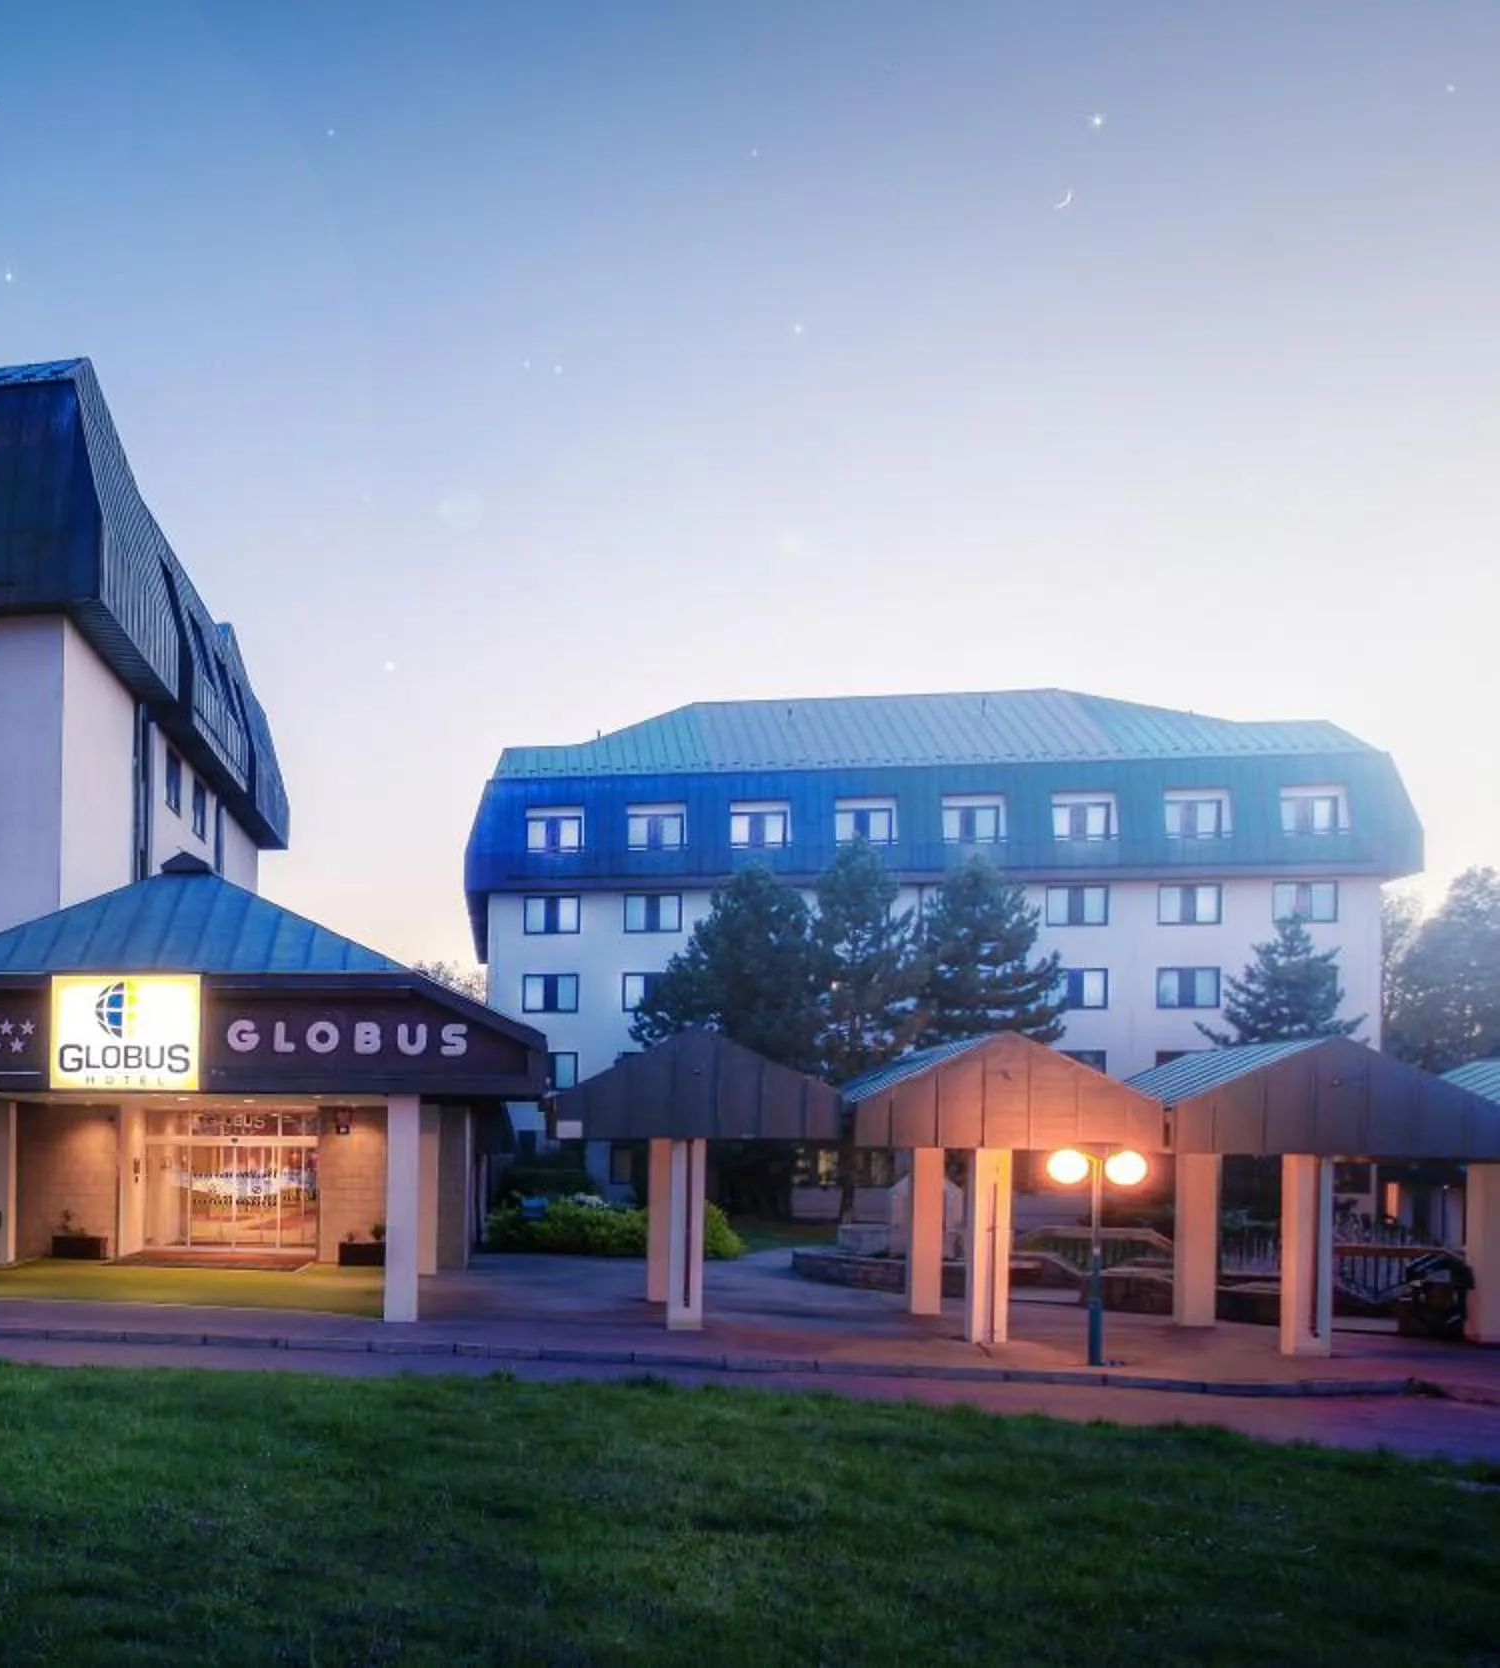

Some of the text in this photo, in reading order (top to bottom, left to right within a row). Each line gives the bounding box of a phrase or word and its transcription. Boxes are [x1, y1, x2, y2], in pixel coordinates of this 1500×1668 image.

[227, 1019, 468, 1056] GLOBUS
[59, 1044, 190, 1073] GLOBUS
[86, 1075, 164, 1086] HOTEL
